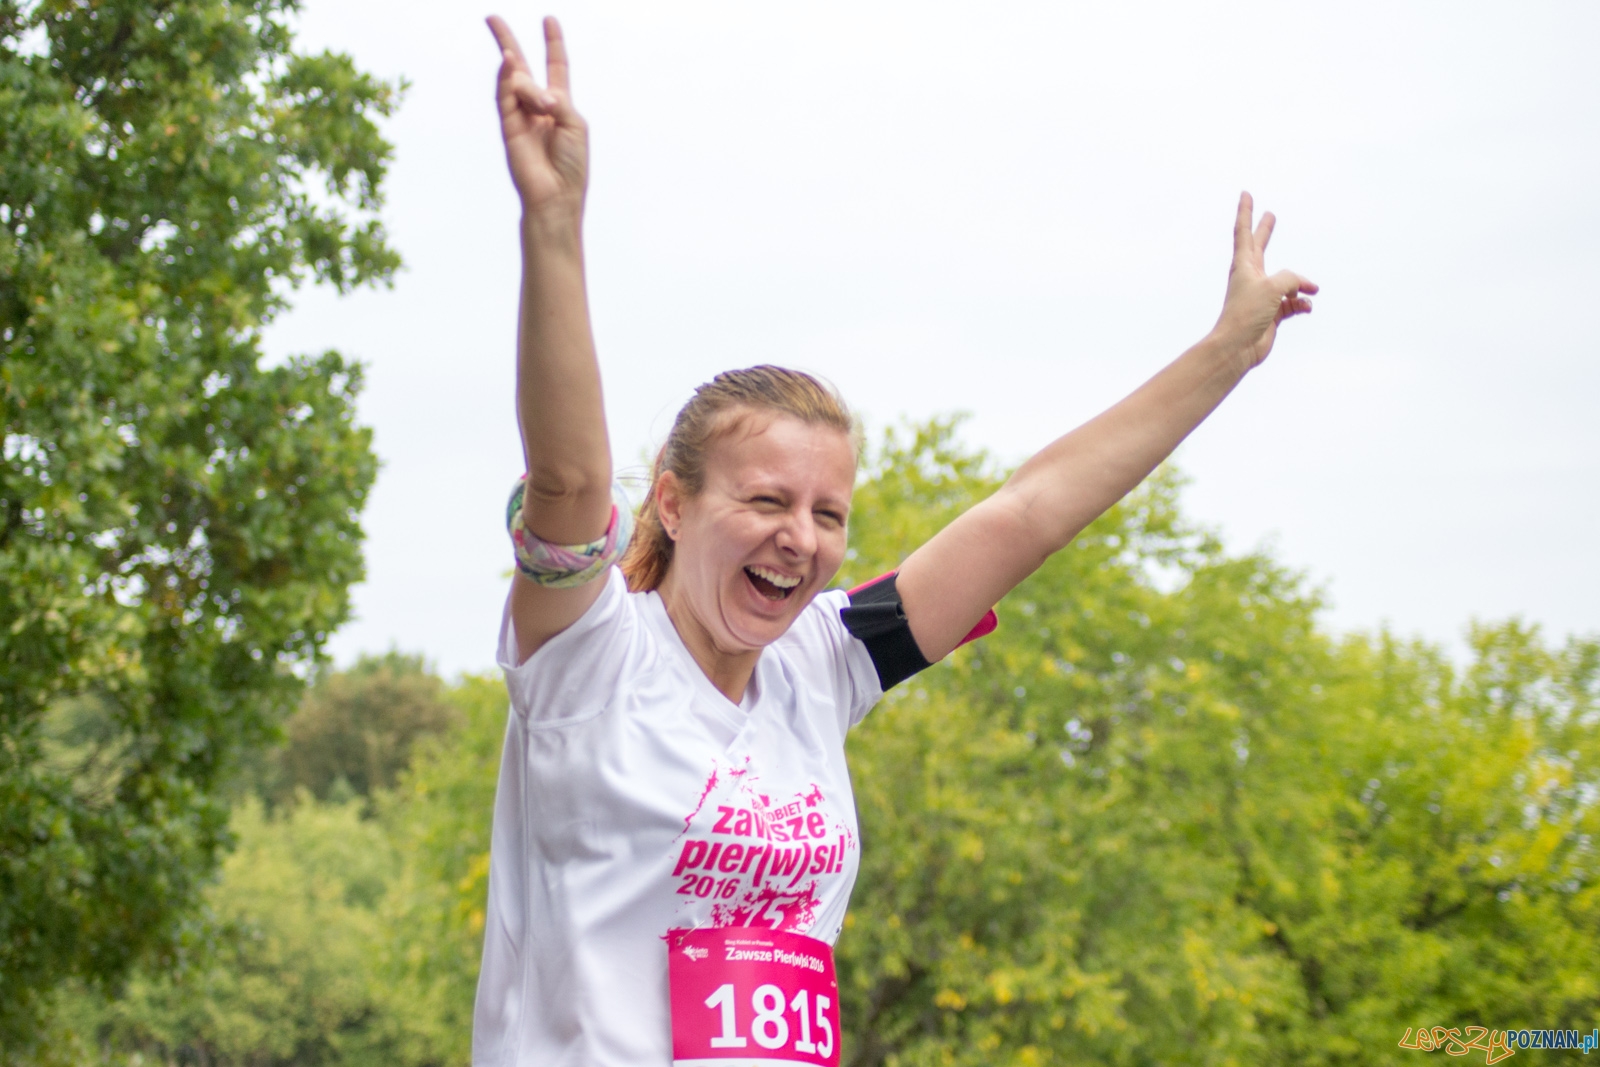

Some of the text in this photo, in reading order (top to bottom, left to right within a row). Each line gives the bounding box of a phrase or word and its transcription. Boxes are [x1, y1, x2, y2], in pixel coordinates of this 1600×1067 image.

[676, 874, 740, 899] 2016
[725, 947, 772, 962] Zawsze
[809, 956, 825, 973] 2016
[704, 983, 834, 1059] 1815
